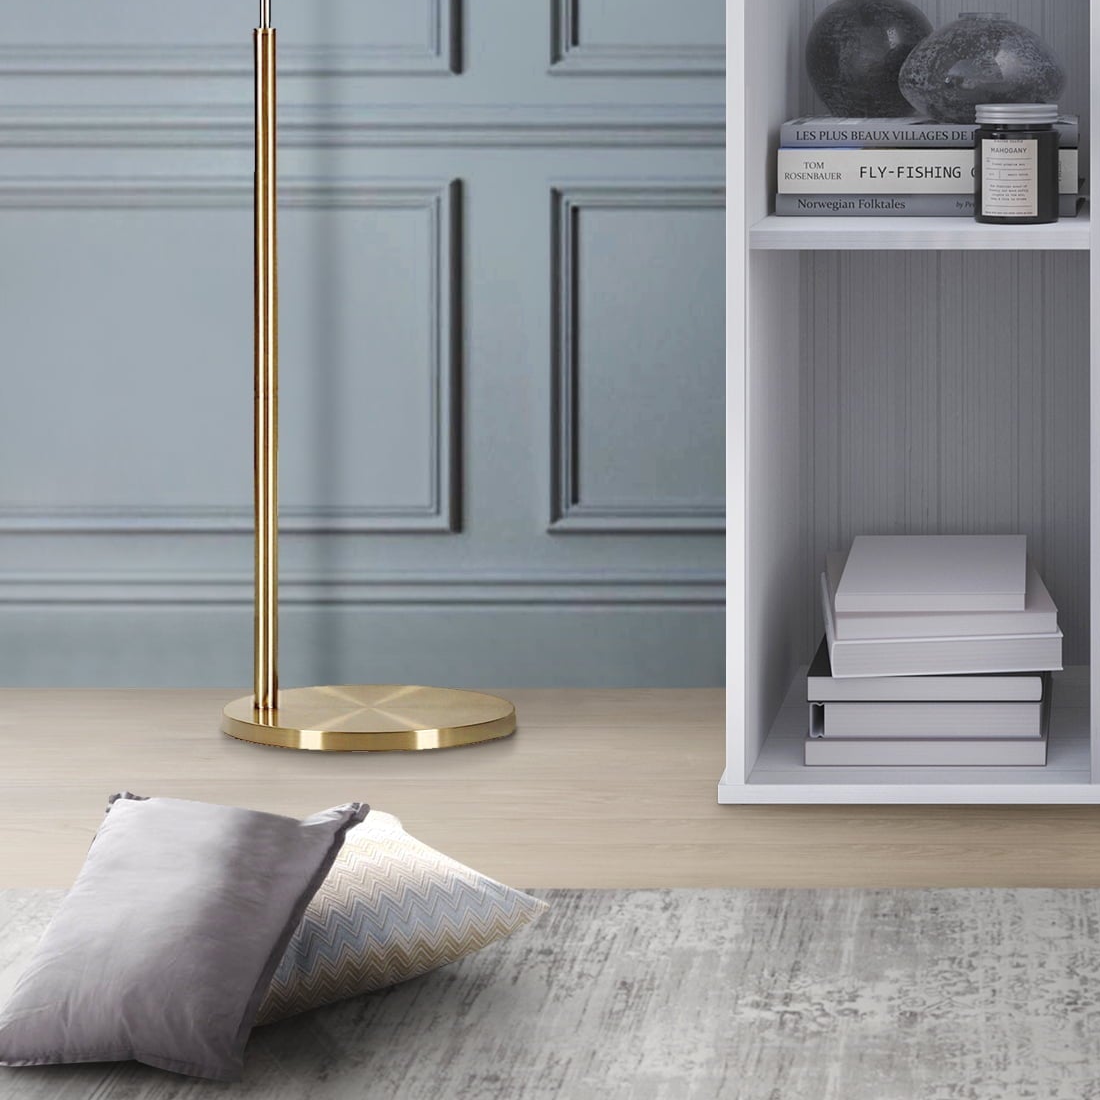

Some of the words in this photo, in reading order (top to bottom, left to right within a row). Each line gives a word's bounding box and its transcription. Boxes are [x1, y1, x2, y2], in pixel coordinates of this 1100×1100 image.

[796, 130, 817, 141] LES
[819, 130, 848, 141] PLUS
[851, 130, 890, 141] BEAUX
[892, 130, 949, 141] VILLAGES
[951, 130, 968, 141] DE
[803, 161, 825, 170] TOM
[784, 172, 843, 181] ROSENBAUER
[859, 166, 962, 179] FLY-FISHING
[797, 198, 856, 211] Norwegian
[858, 198, 906, 210] Folktales
